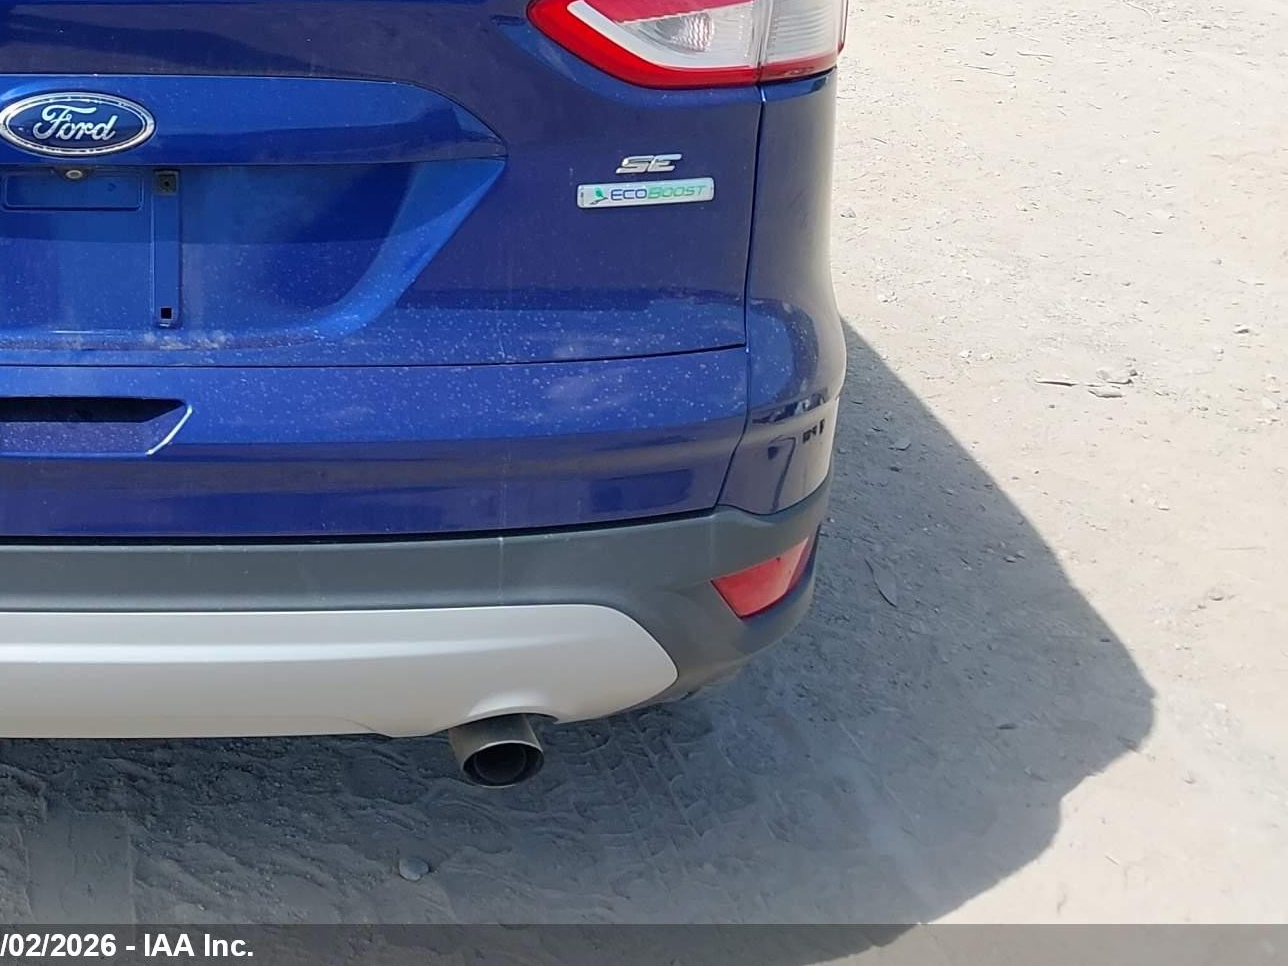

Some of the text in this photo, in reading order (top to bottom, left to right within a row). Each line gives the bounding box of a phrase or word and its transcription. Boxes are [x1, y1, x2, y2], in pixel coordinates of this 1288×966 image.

[32, 104, 119, 141] Ford
[615, 153, 683, 174] SE
[610, 185, 707, 202] ECOBOOST
